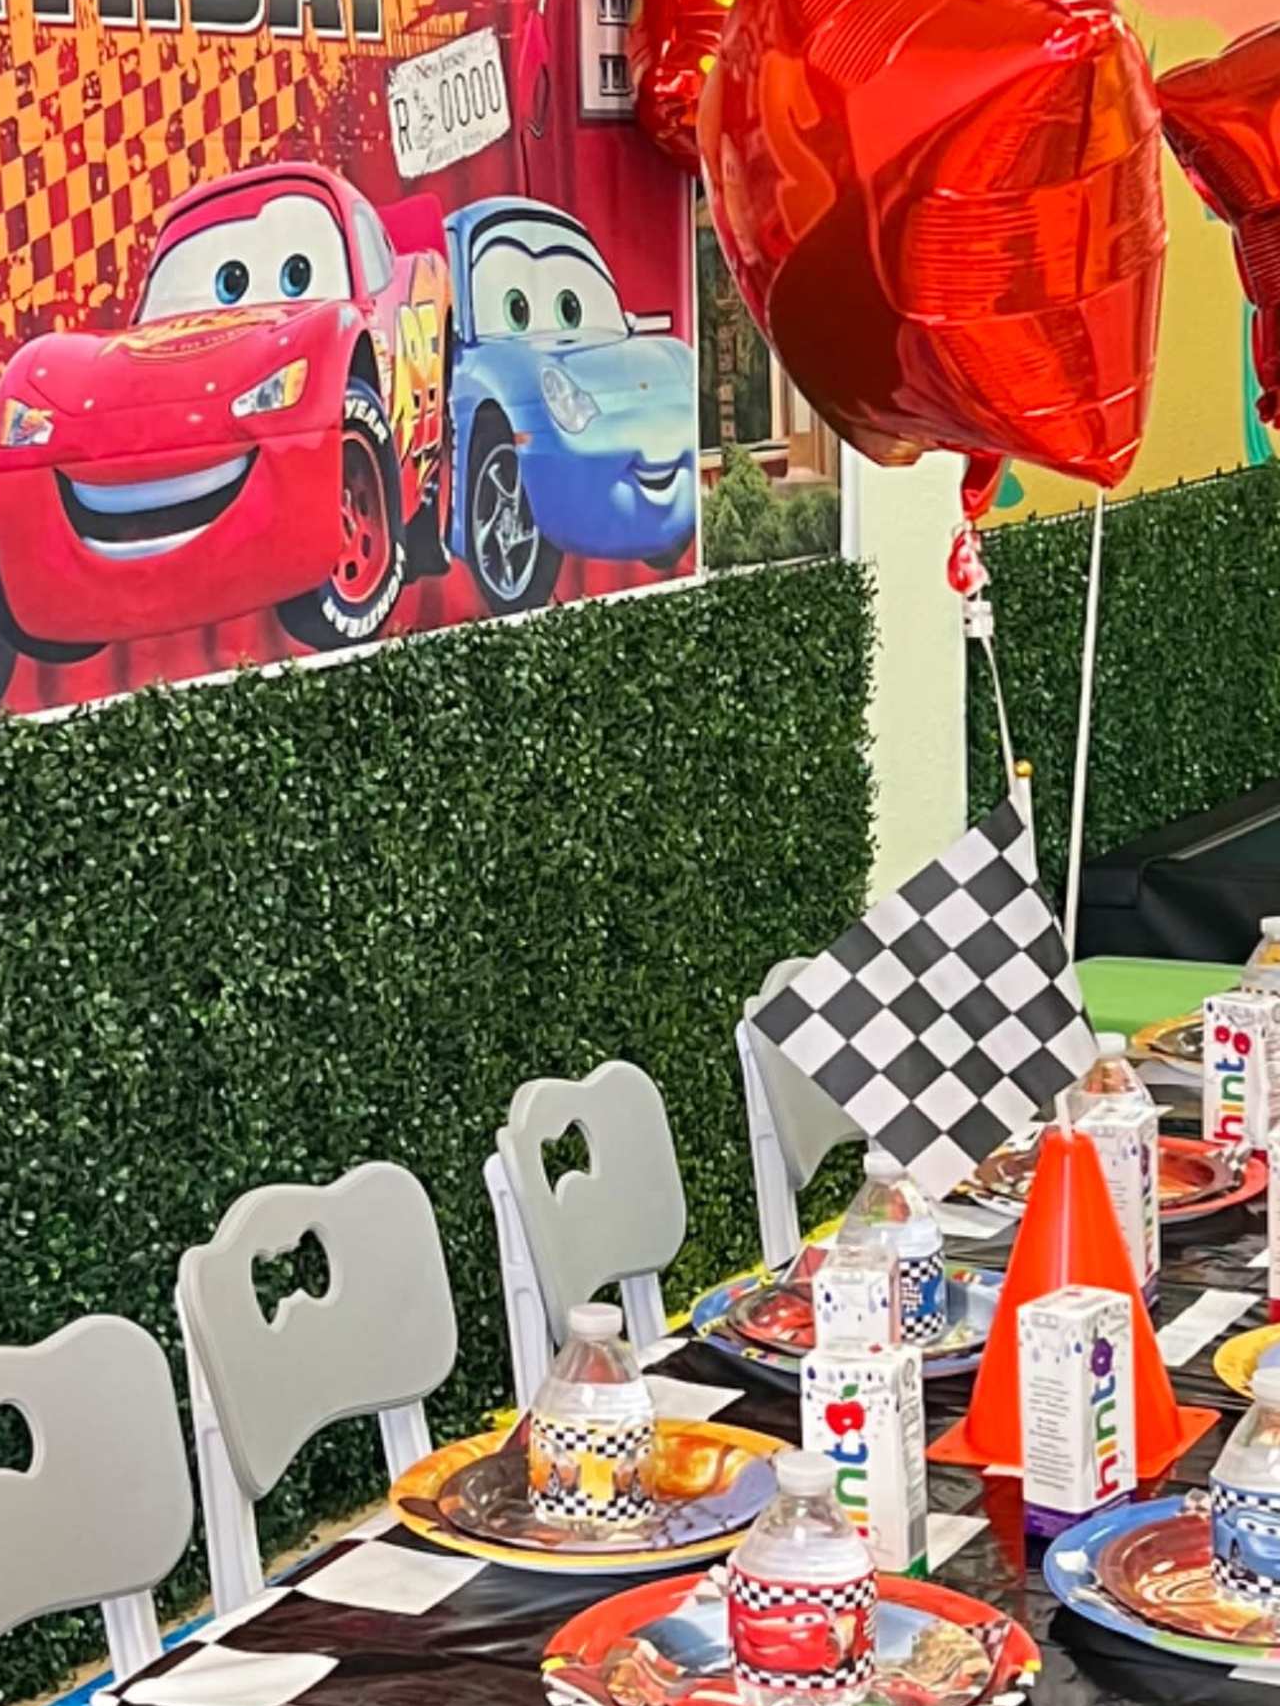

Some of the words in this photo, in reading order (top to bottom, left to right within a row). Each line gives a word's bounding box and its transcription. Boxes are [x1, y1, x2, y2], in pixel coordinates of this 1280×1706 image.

[392, 96, 413, 156] R
[438, 58, 503, 134] 0000
[1214, 1055, 1247, 1150] hint
[1090, 1373, 1121, 1502] hint
